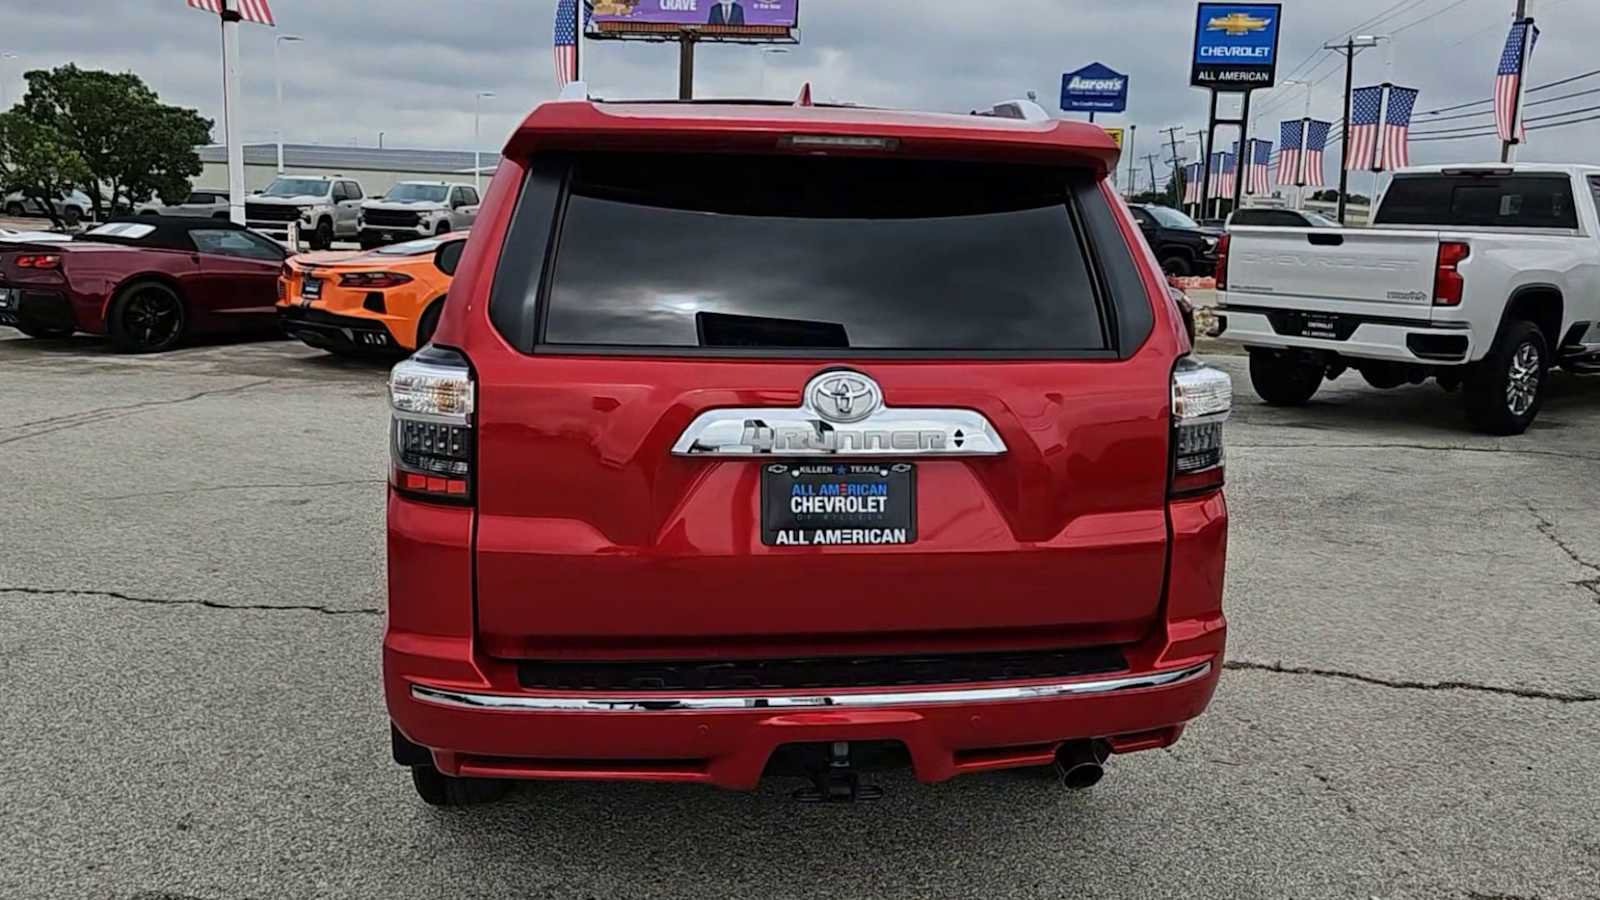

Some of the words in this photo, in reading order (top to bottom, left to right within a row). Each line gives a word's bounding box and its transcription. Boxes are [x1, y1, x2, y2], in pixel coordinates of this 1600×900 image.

[1200, 46, 1270, 57] CHEVROLET
[1198, 71, 1216, 80] ALL
[1219, 71, 1269, 81] AMERICAN
[1067, 76, 1122, 90] Aaron's
[850, 465, 880, 473] TEXAS
[792, 484, 816, 495] ALL
[819, 484, 887, 495] AMERICAN
[791, 496, 887, 513] CHEVROLET
[776, 529, 809, 545] ALL
[813, 528, 906, 544] AMERICAN
